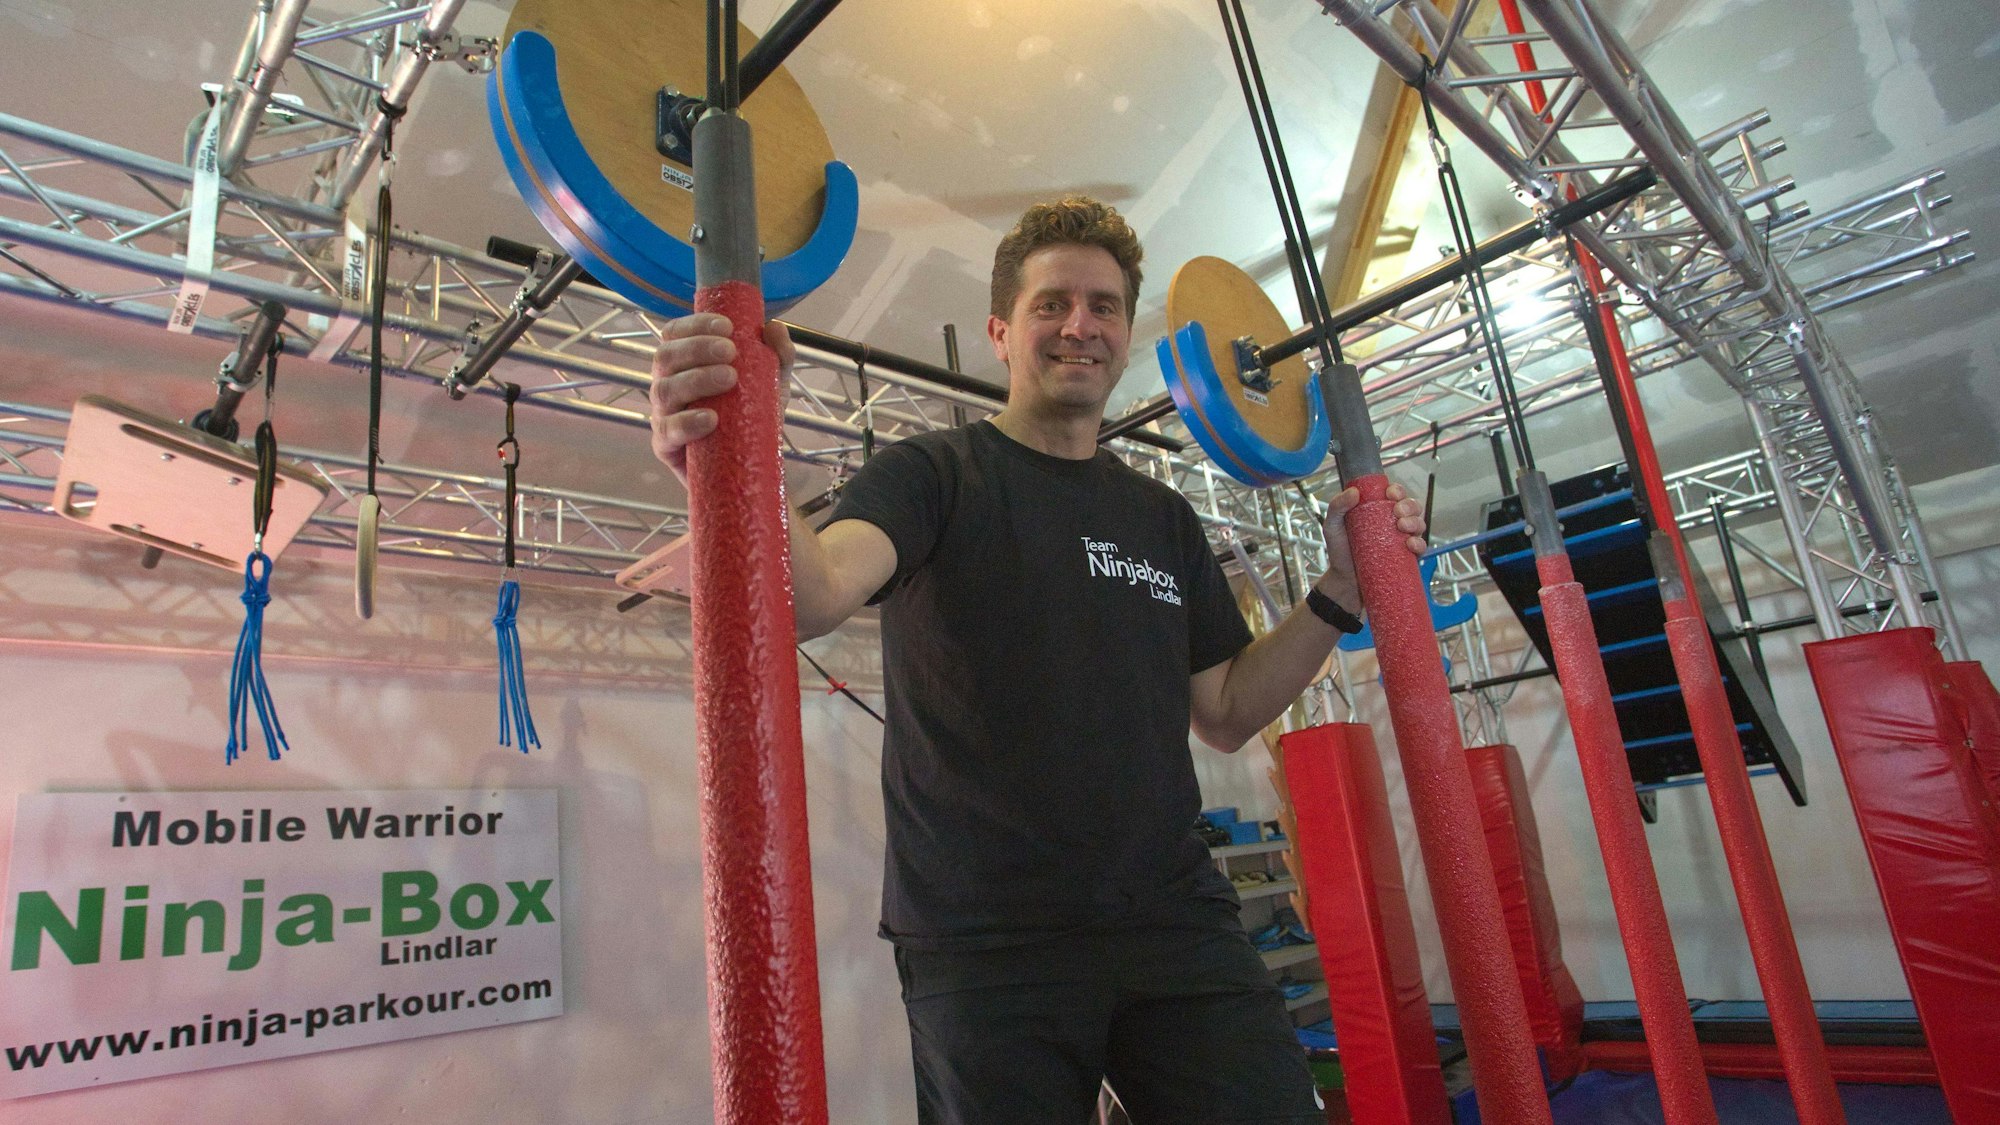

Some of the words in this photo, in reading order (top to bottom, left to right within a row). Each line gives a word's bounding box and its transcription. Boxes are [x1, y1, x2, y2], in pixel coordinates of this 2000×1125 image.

[1080, 536, 1119, 553] Team
[1087, 552, 1179, 592] Ninjabox
[112, 808, 306, 848] Mobile
[326, 806, 503, 840] Warrior
[10, 869, 556, 972] Ninja-Box
[380, 934, 498, 966] Lindlar
[4, 977, 553, 1071] www.ninja-parkour.com
